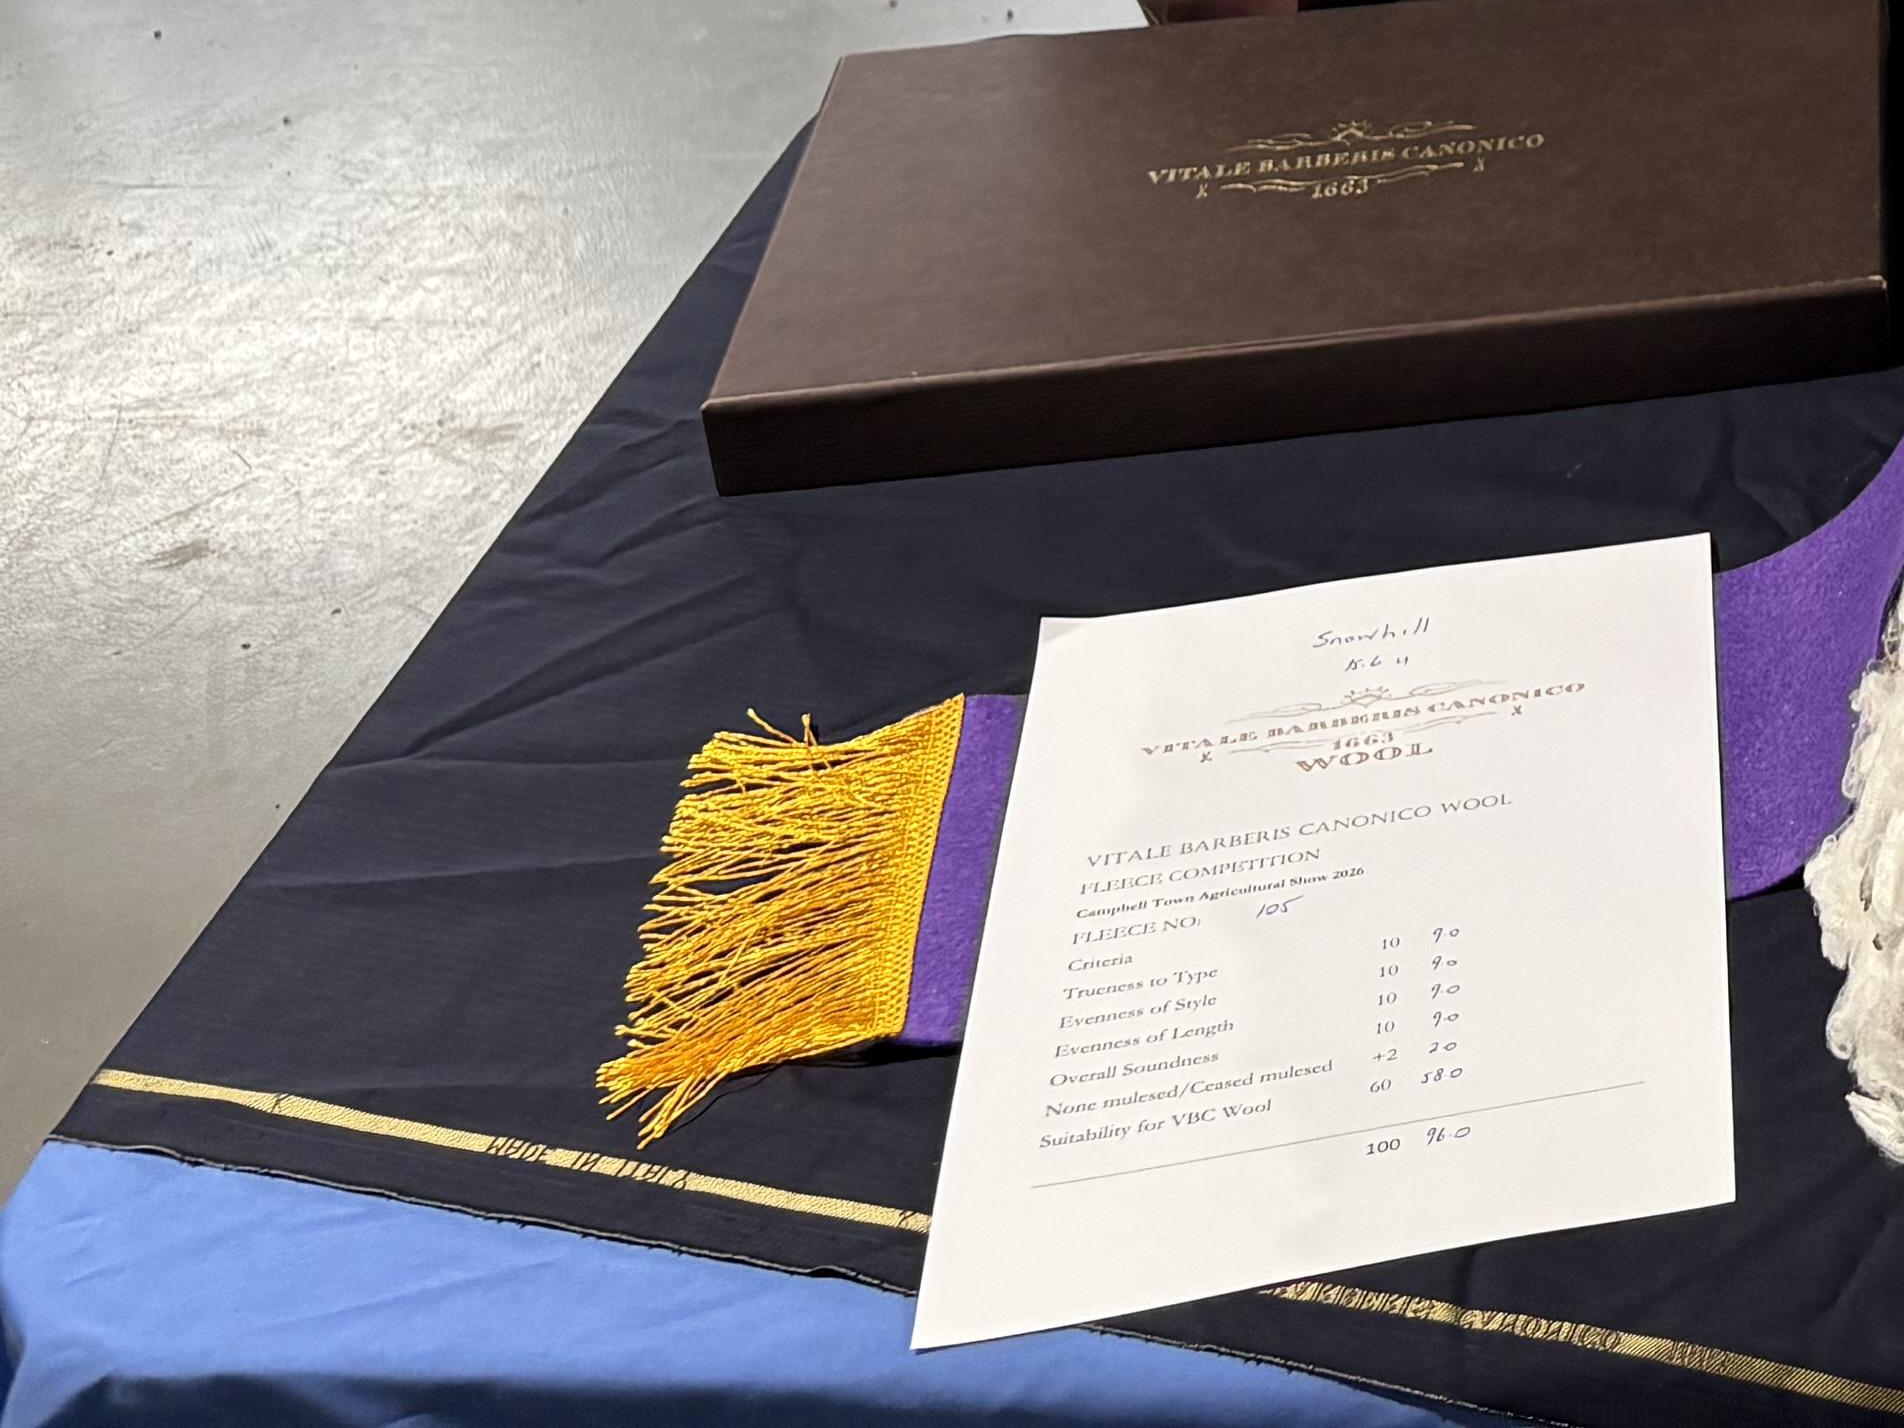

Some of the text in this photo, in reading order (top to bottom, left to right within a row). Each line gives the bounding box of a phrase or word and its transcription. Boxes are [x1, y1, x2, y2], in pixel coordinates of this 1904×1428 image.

[1148, 133, 1545, 185] VITALE BARBERIS CANONICO
[1311, 178, 1370, 199] 1663
[1312, 617, 1430, 648] Snowhill
[1141, 681, 1587, 756] VITALE BARBERIS CANONICO
[1332, 730, 1394, 749] 1663
[1296, 742, 1434, 773] WOOL
[1086, 793, 1513, 869] VITALE BARBERIS CANONICO WOOL
[1080, 849, 1320, 896] FLEECE COMPETITION
[1075, 898, 1147, 920] Campbell
[1152, 890, 1195, 907] Town
[1199, 877, 1286, 902] Agricultural
[1289, 873, 1328, 887] Show
[1256, 895, 1304, 920] 105
[1072, 922, 1158, 945] FLEECE
[1380, 937, 1401, 951] 10
[1066, 953, 1134, 973] Criteria
[1378, 965, 1399, 980] 10
[1063, 967, 1219, 1001] Trueness to Type
[1376, 992, 1397, 1007] 10
[1058, 993, 1218, 1030] Evenness of Style
[1053, 1019, 1235, 1059] Evenness of Length
[1374, 1020, 1395, 1036] 10
[1049, 1049, 1220, 1087] Overall Soundness
[1371, 1048, 1398, 1064] +2
[1044, 1060, 1333, 1119] None mulesed/Ceased mulesed
[1369, 1077, 1392, 1094] 60
[1039, 1098, 1273, 1150] Suitability for VBC Wool
[1365, 1137, 1402, 1156] 100
